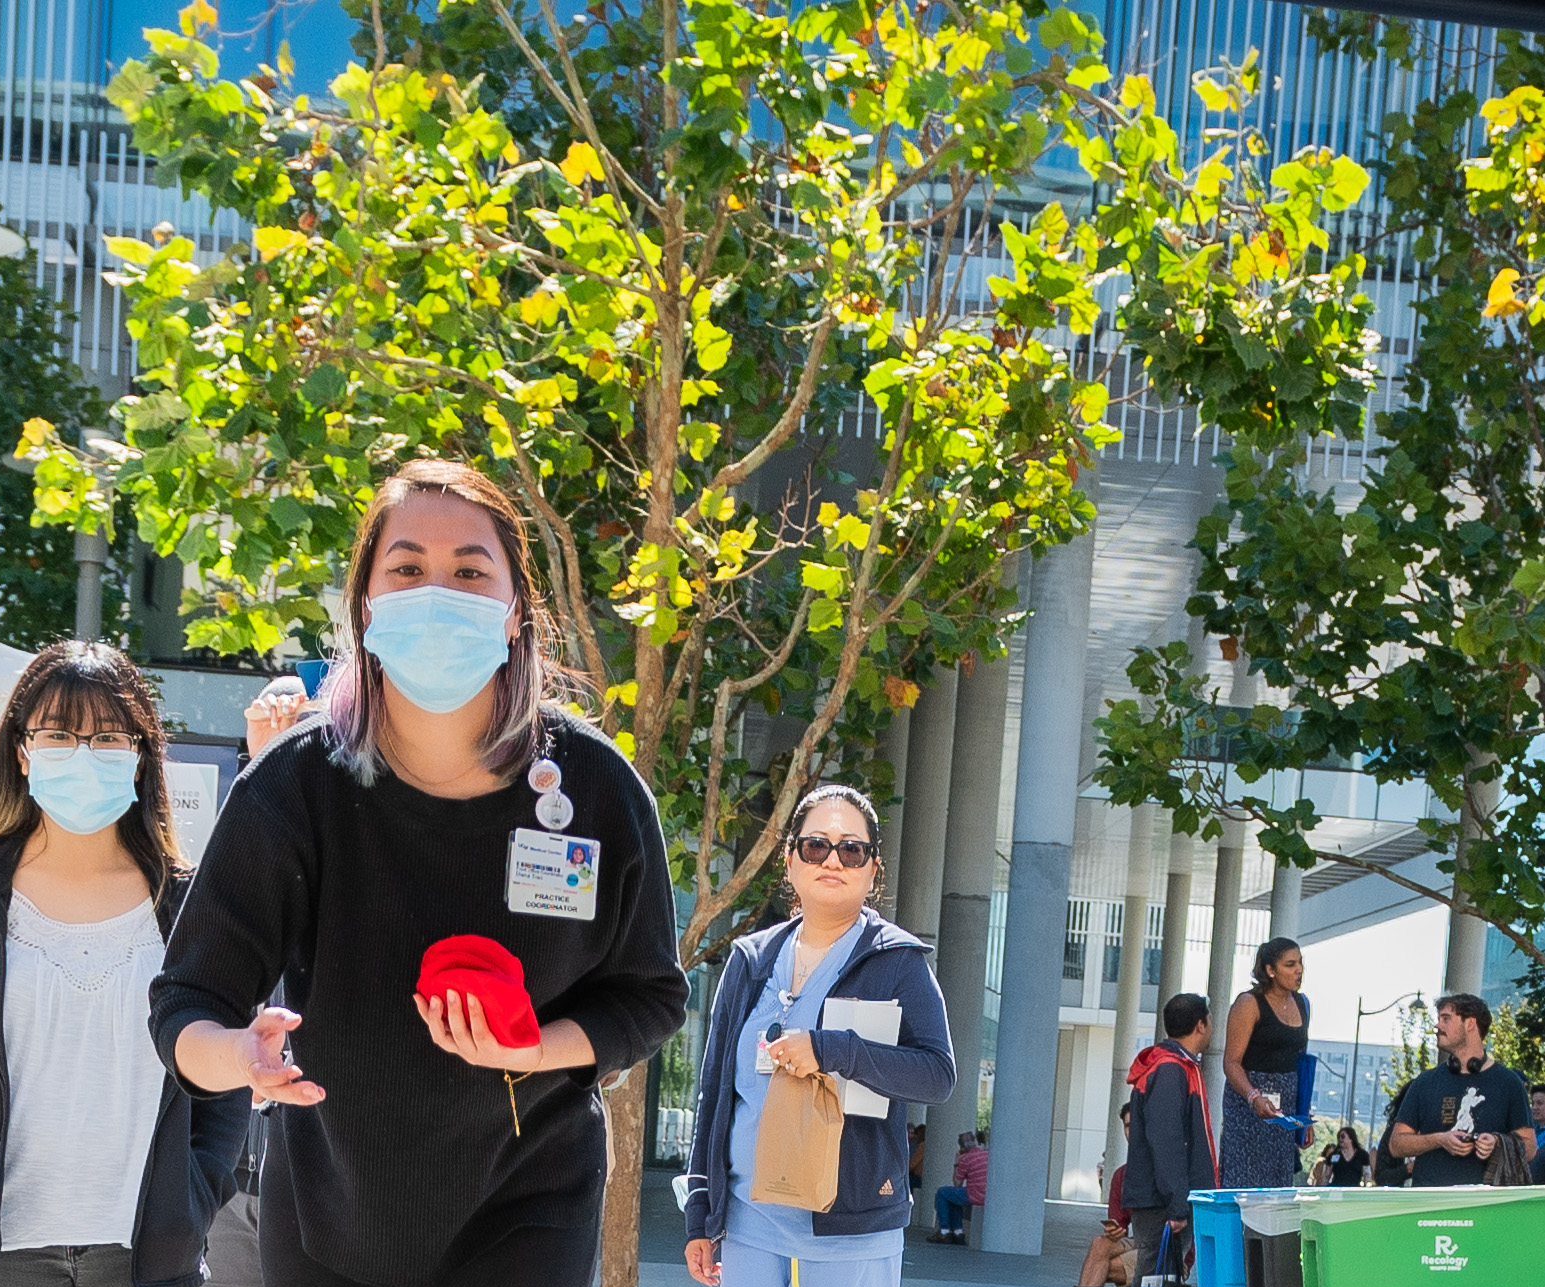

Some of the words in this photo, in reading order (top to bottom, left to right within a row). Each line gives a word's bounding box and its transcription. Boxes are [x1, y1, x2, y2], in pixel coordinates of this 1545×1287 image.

[171, 798, 199, 810] ONS
[534, 893, 570, 902] PRACTICE
[525, 901, 578, 913] COORDINATOR
[1421, 1255, 1469, 1267] Recology
